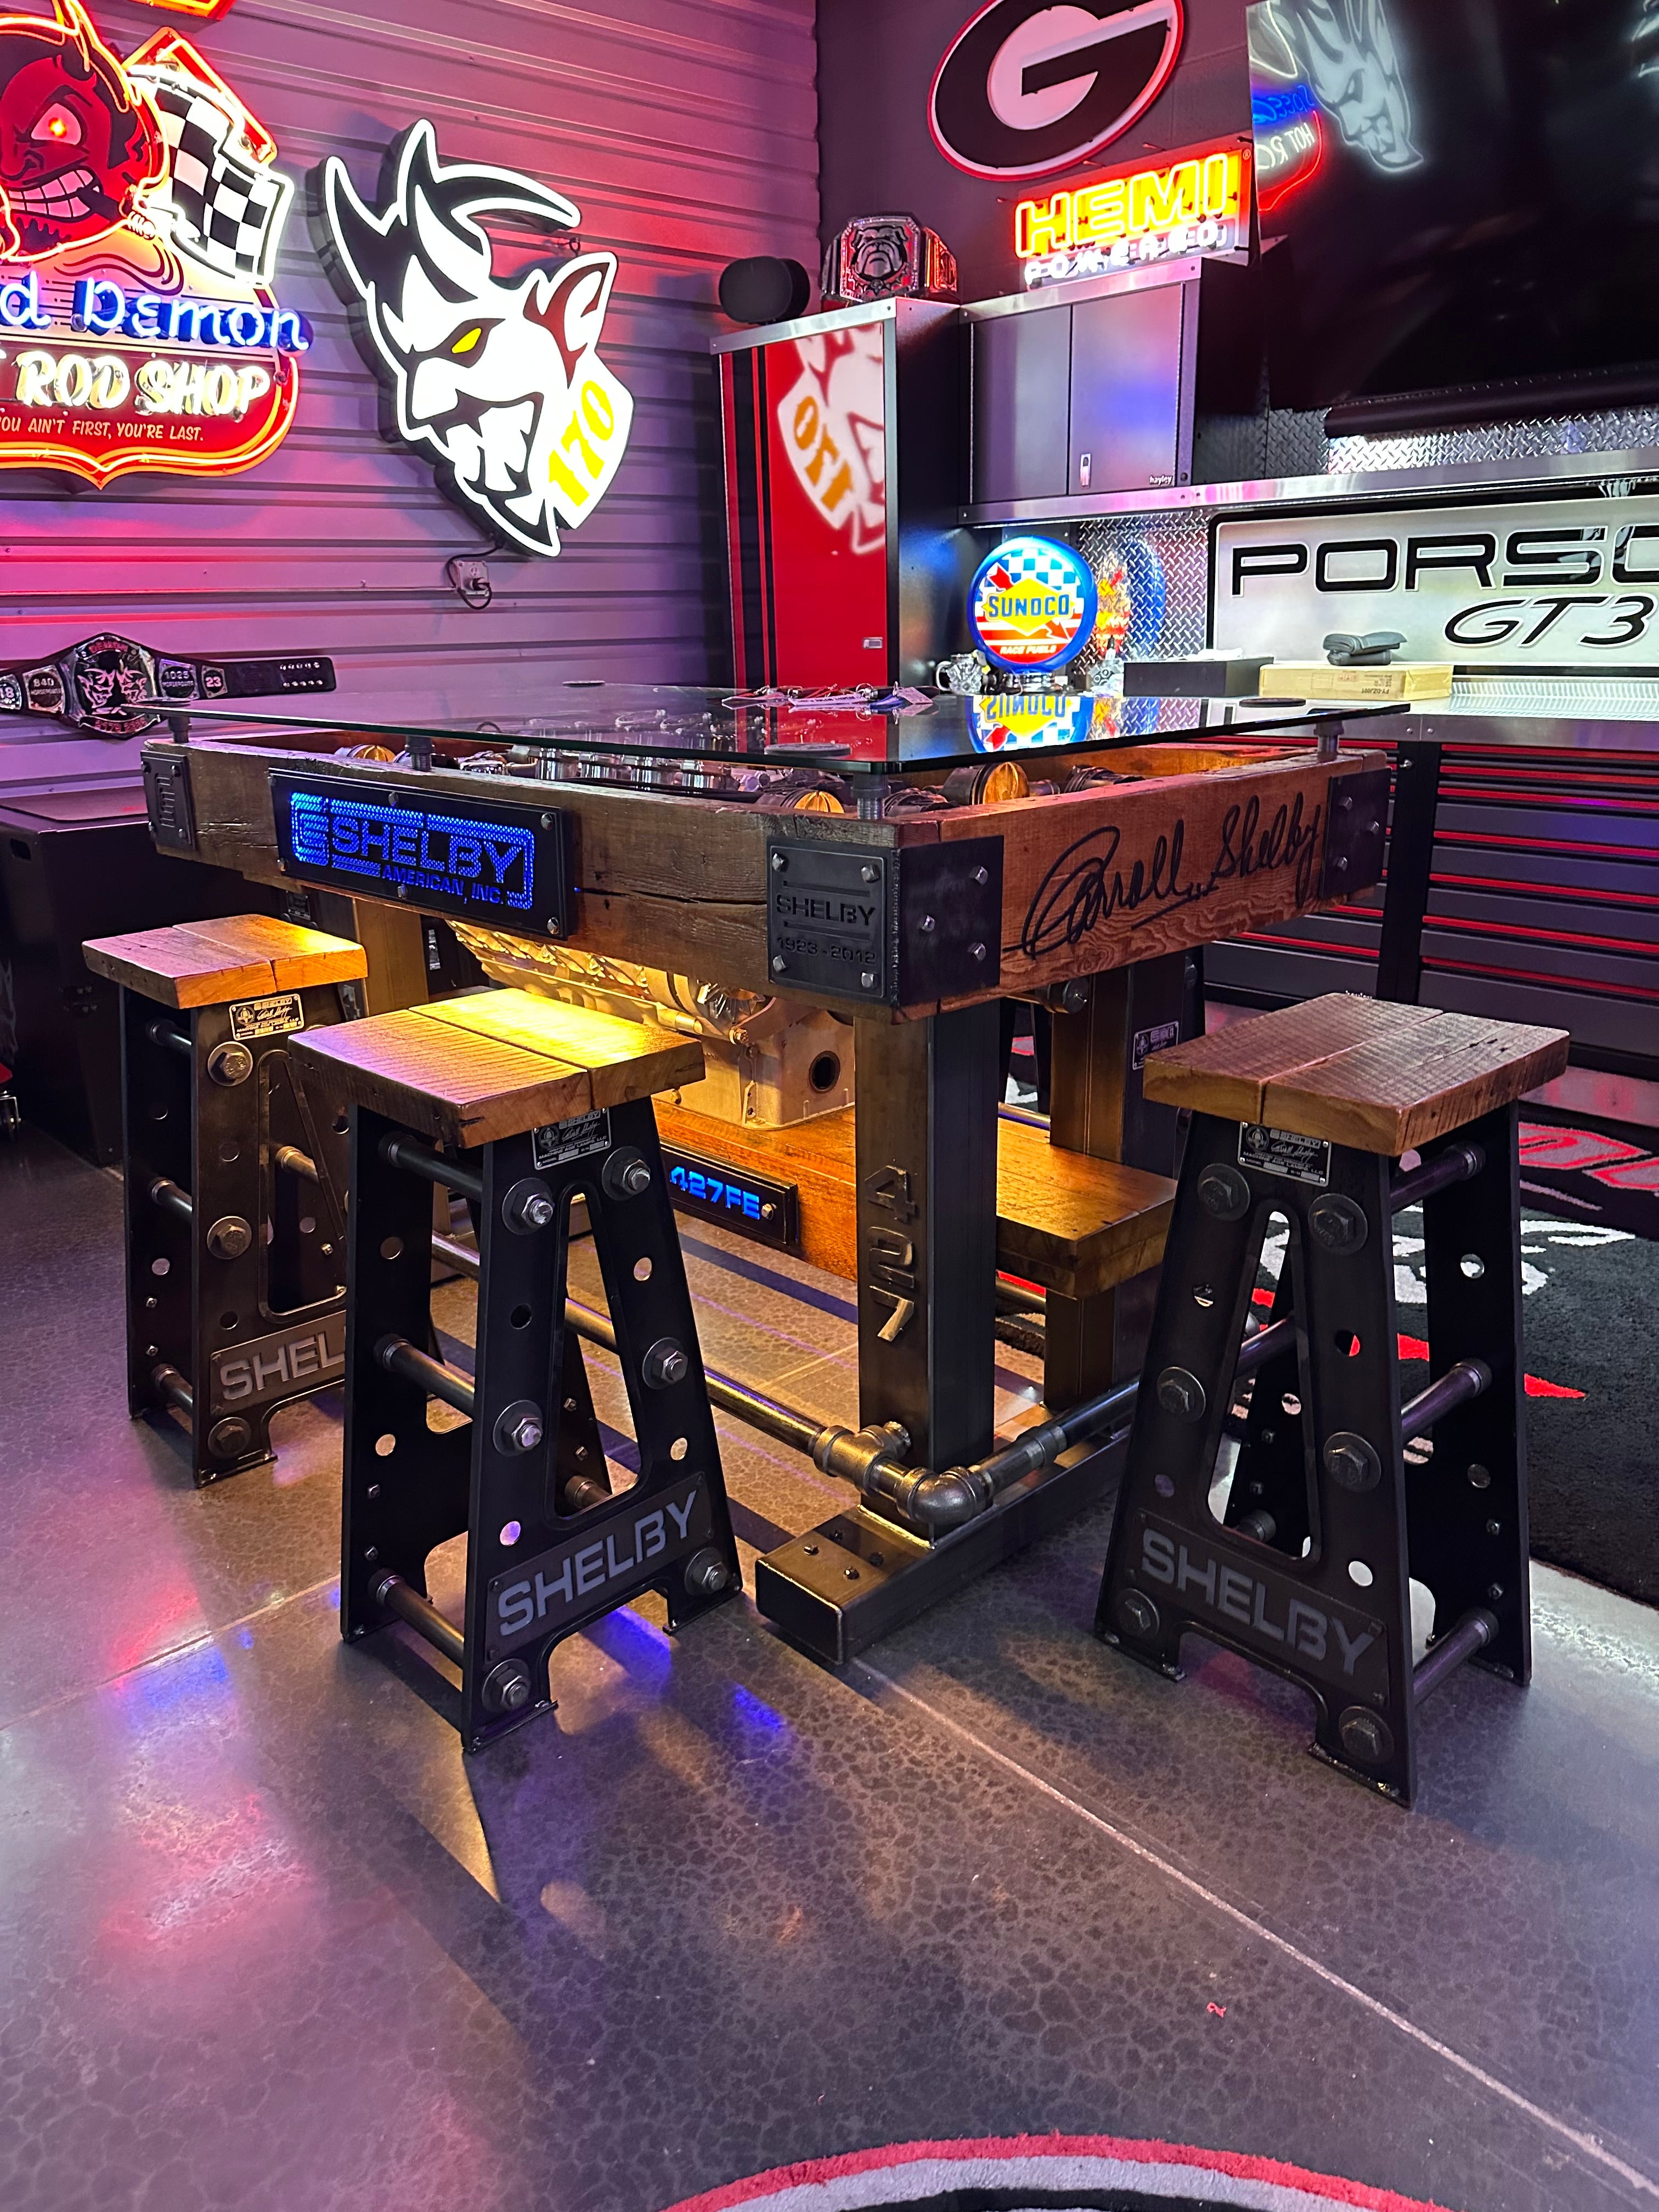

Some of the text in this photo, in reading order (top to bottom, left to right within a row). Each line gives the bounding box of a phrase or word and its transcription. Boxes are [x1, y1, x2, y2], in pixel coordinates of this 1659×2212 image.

[1015, 153, 1229, 258] HEMI
[13, 350, 270, 417] ROD SHOP
[28, 418, 65, 435] AIN'T
[72, 420, 111, 439] FIRST,
[116, 422, 164, 439] YOU'RE
[170, 425, 204, 441] LAST.
[549, 380, 614, 507] 170
[1150, 475, 1172, 486] hayley
[989, 594, 1069, 618] SUNOCO
[1000, 645, 1057, 654] RACE FUELS
[164, 670, 189, 679] 1025
[205, 676, 222, 687] 23
[332, 816, 523, 884] SHELBY
[382, 864, 505, 905] AMERICAN, INC.
[776, 894, 876, 927] SHELBY
[669, 1165, 760, 1220] 427FE
[220, 1330, 346, 1400] SHEL
[498, 1489, 697, 1637] SHELBY
[1142, 1528, 1375, 1676] SHELBY
